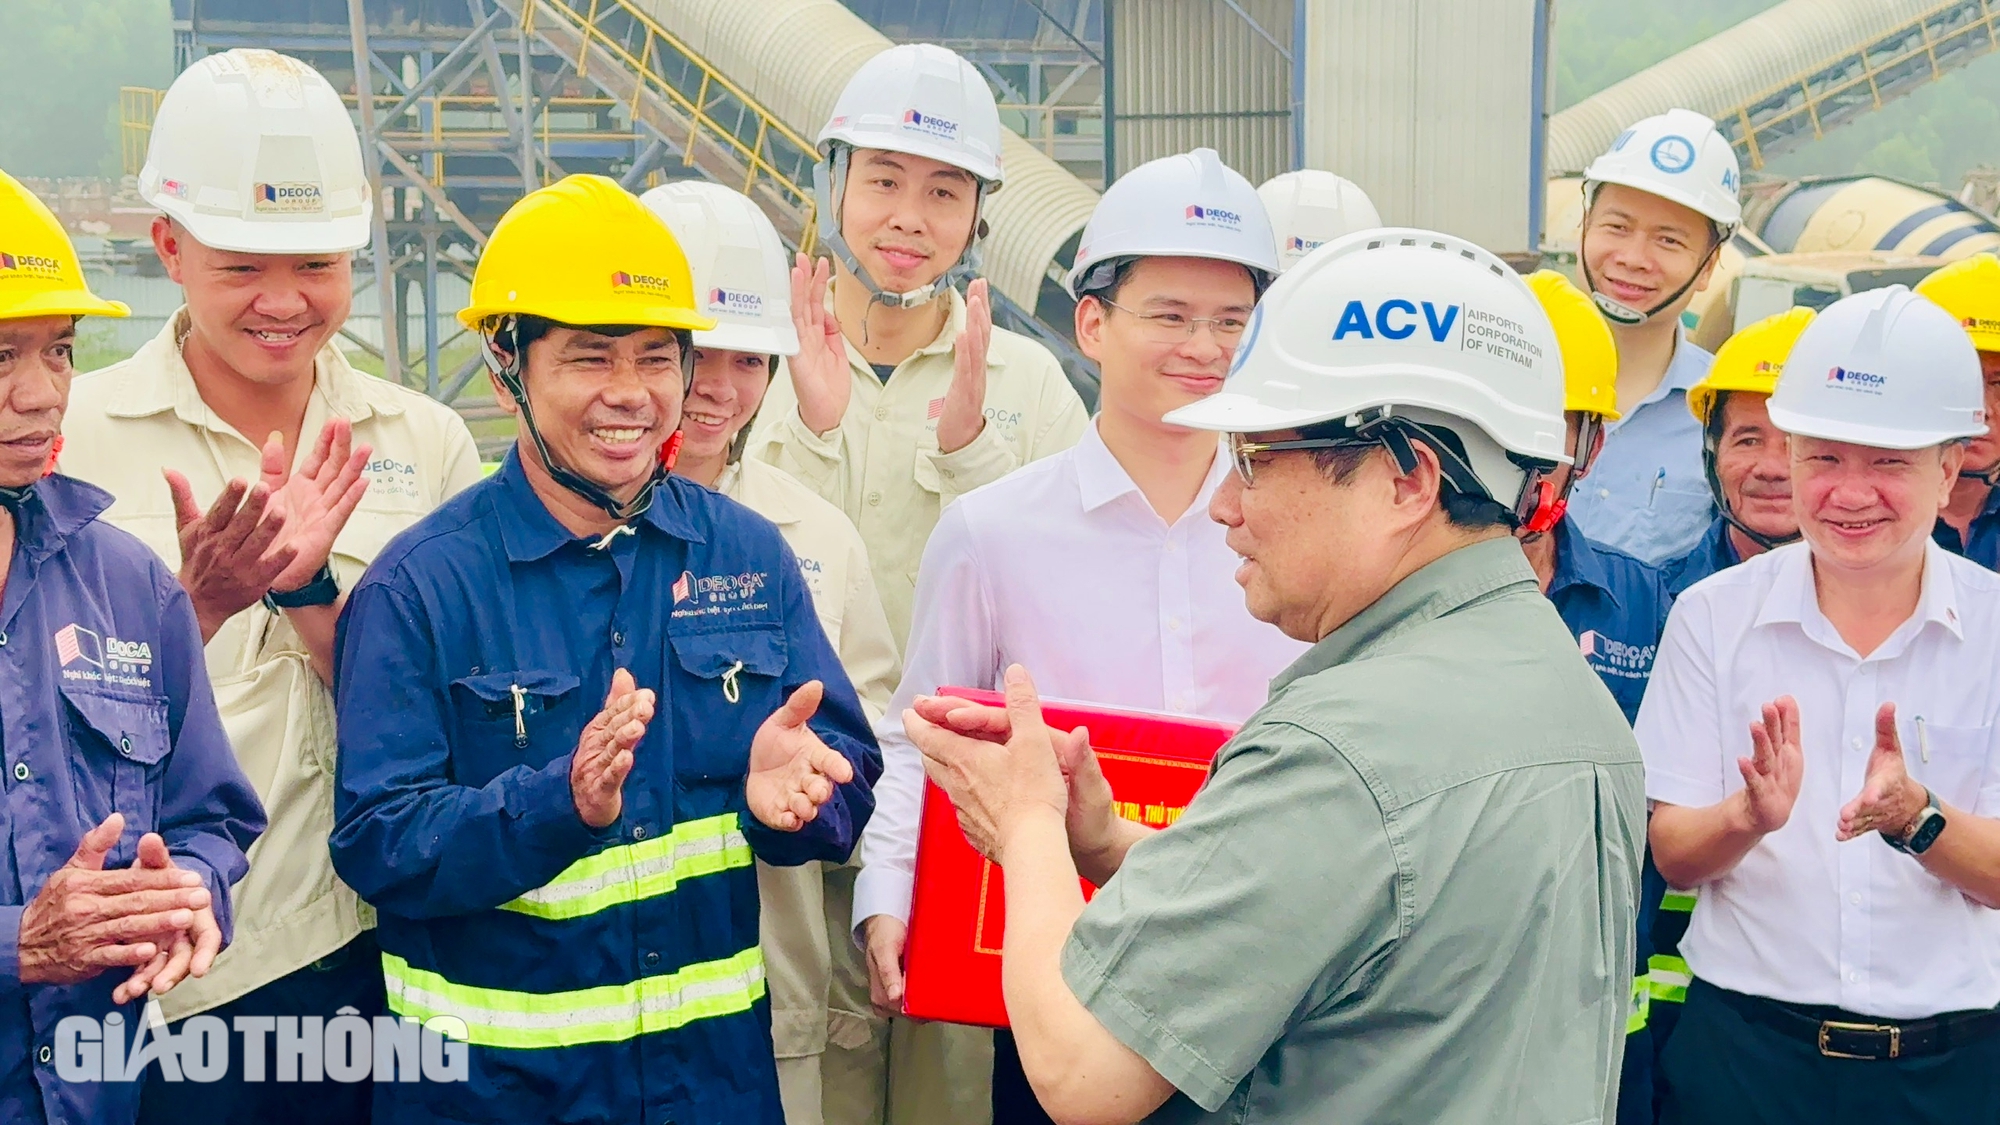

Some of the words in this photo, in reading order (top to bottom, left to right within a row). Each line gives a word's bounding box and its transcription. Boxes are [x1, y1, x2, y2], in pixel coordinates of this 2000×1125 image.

[923, 115, 957, 131] DEOCA
[278, 187, 321, 197] DEOCA
[1205, 208, 1241, 223] DEOCA
[17, 255, 61, 270] DEOCA
[632, 274, 669, 288] DEOCA
[728, 292, 762, 305] DEOCA
[1332, 298, 1460, 343] ACV
[1467, 308, 1524, 335] AIRPORTS
[1467, 323, 1543, 359] CORPORATION
[1466, 338, 1483, 351] OF
[1486, 342, 1533, 370] VIETNAM
[1847, 370, 1885, 385] DEOCA
[698, 572, 764, 593] DEOCA
[1605, 639, 1653, 661] DEOCA
